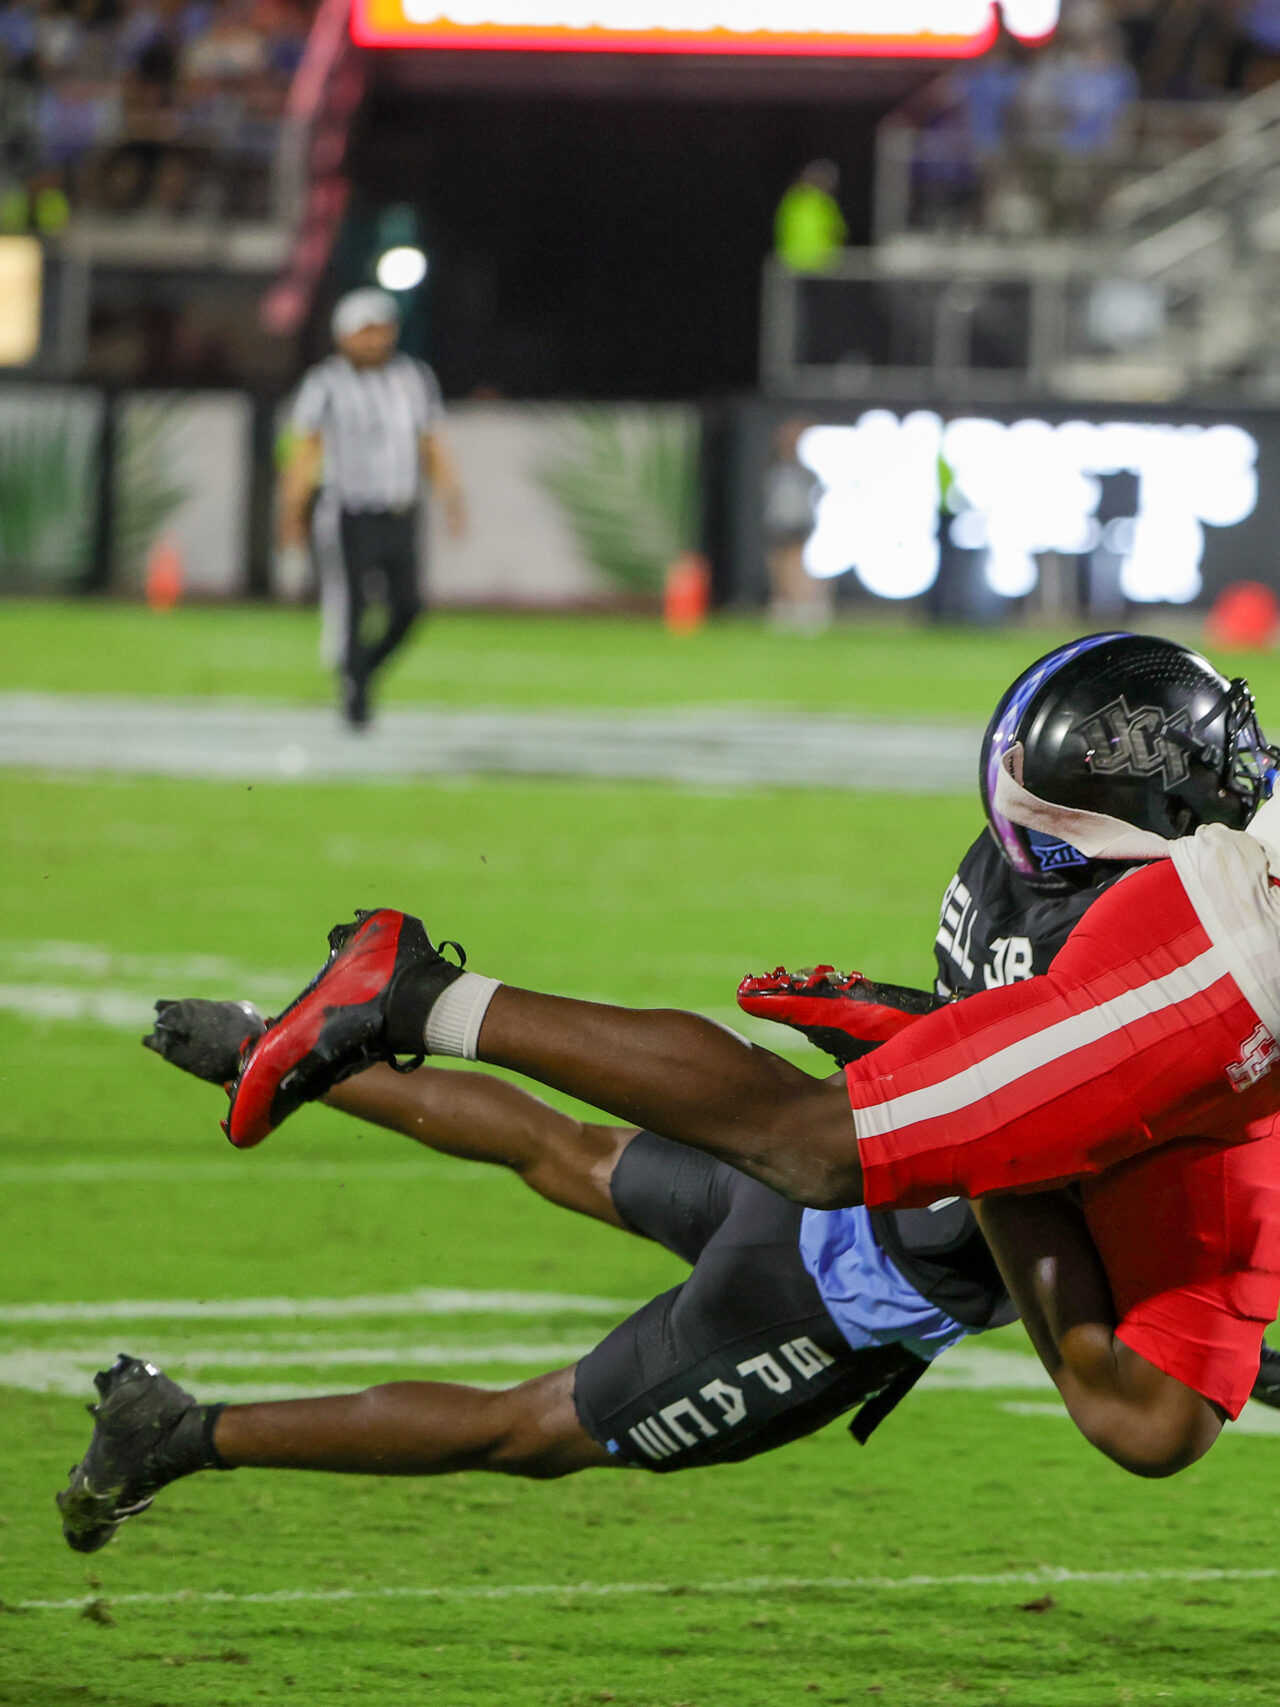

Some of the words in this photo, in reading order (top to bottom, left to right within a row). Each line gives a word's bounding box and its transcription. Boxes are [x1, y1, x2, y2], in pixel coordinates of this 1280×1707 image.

[1074, 694, 1196, 792] UCF
[983, 936, 1034, 990] JR
[628, 1336, 836, 1460] SPACE
